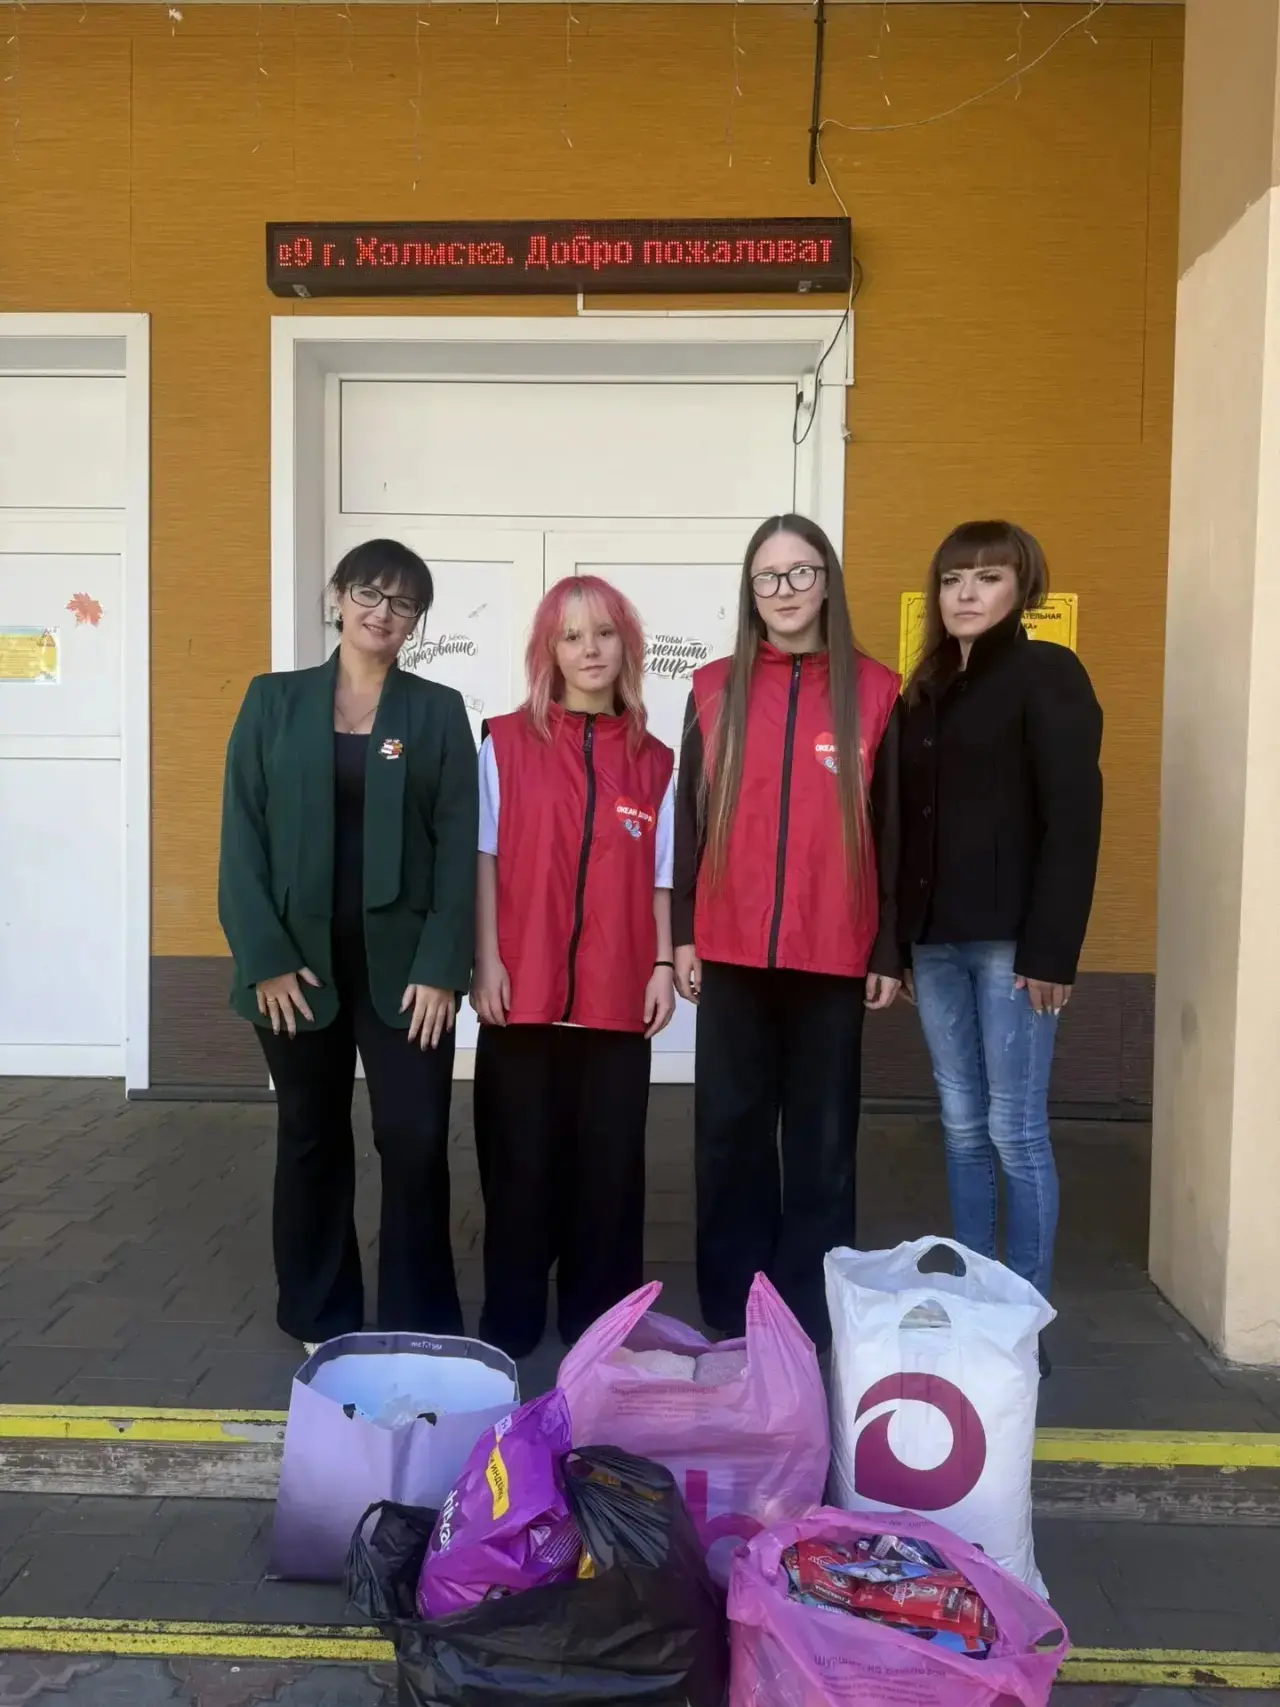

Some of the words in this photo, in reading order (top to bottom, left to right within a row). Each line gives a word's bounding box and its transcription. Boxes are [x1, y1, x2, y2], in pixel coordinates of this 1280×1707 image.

[323, 243, 345, 266] г.
[355, 237, 514, 266] Холмска.
[525, 235, 633, 271] Добро
[643, 239, 833, 264] пожаловат
